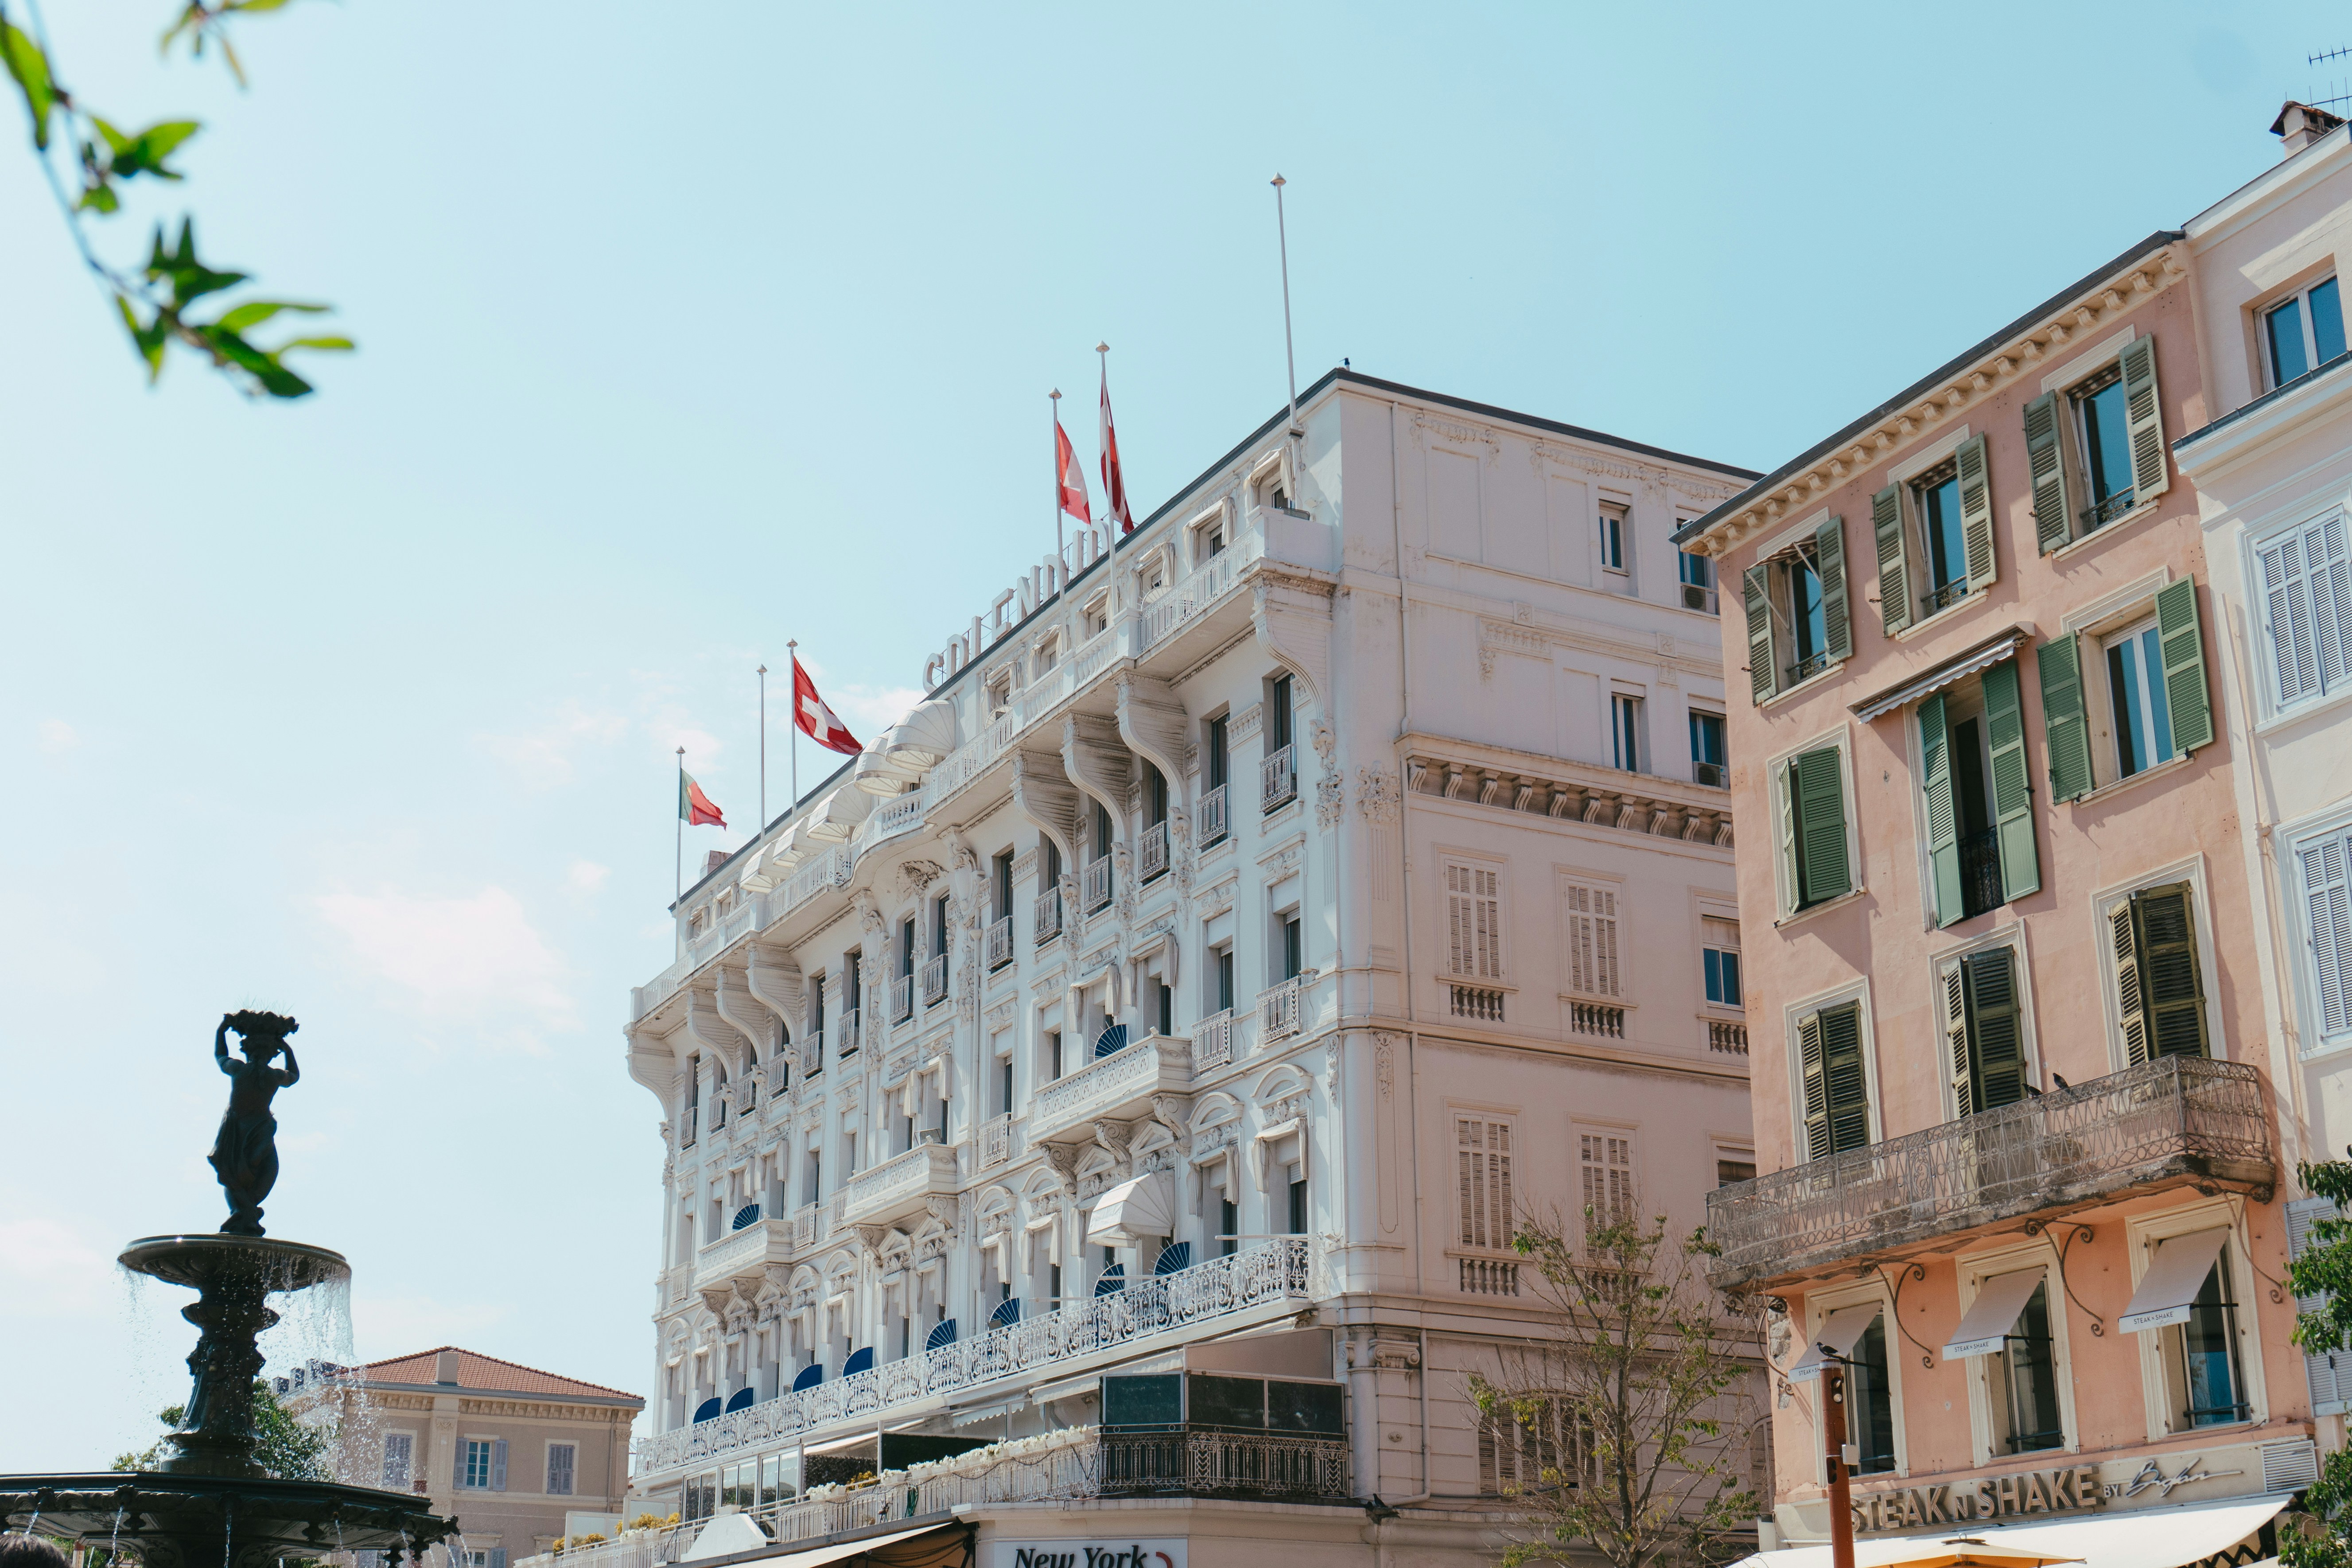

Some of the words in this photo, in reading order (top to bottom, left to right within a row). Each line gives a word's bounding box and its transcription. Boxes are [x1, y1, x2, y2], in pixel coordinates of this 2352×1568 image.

[2134, 1316, 2151, 1324] STEAK
[2156, 1311, 2173, 1320] SHAKE
[1954, 1494, 1972, 1520] N
[1977, 1466, 2098, 1517] SHAKE
[2103, 1484, 2119, 1498] BY
[1015, 1549, 1075, 1568] New
[1083, 1545, 1147, 1568] York
